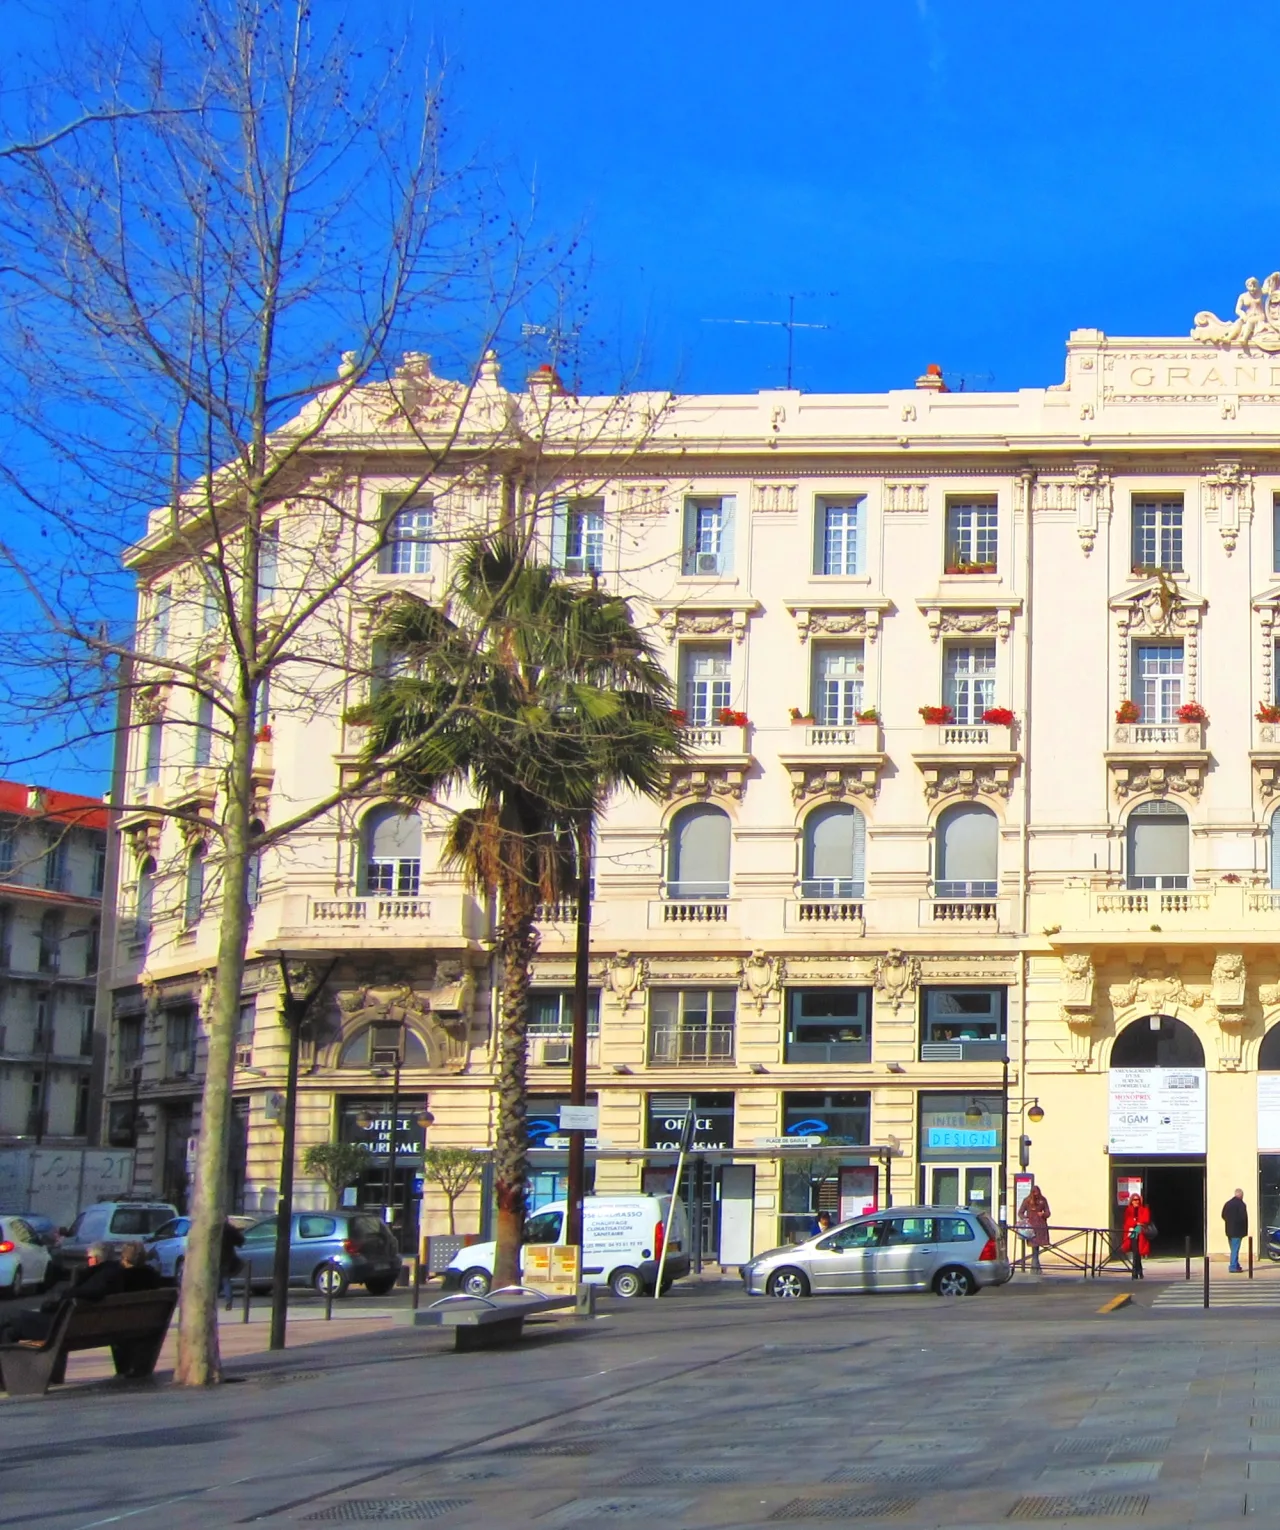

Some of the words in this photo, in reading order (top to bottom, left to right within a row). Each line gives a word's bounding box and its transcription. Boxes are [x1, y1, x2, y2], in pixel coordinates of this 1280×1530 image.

[664, 1119, 714, 1130] OFCE
[1127, 1115, 1149, 1124] GAM
[378, 1132, 393, 1141] DE
[932, 1133, 991, 1146] DESIGN
